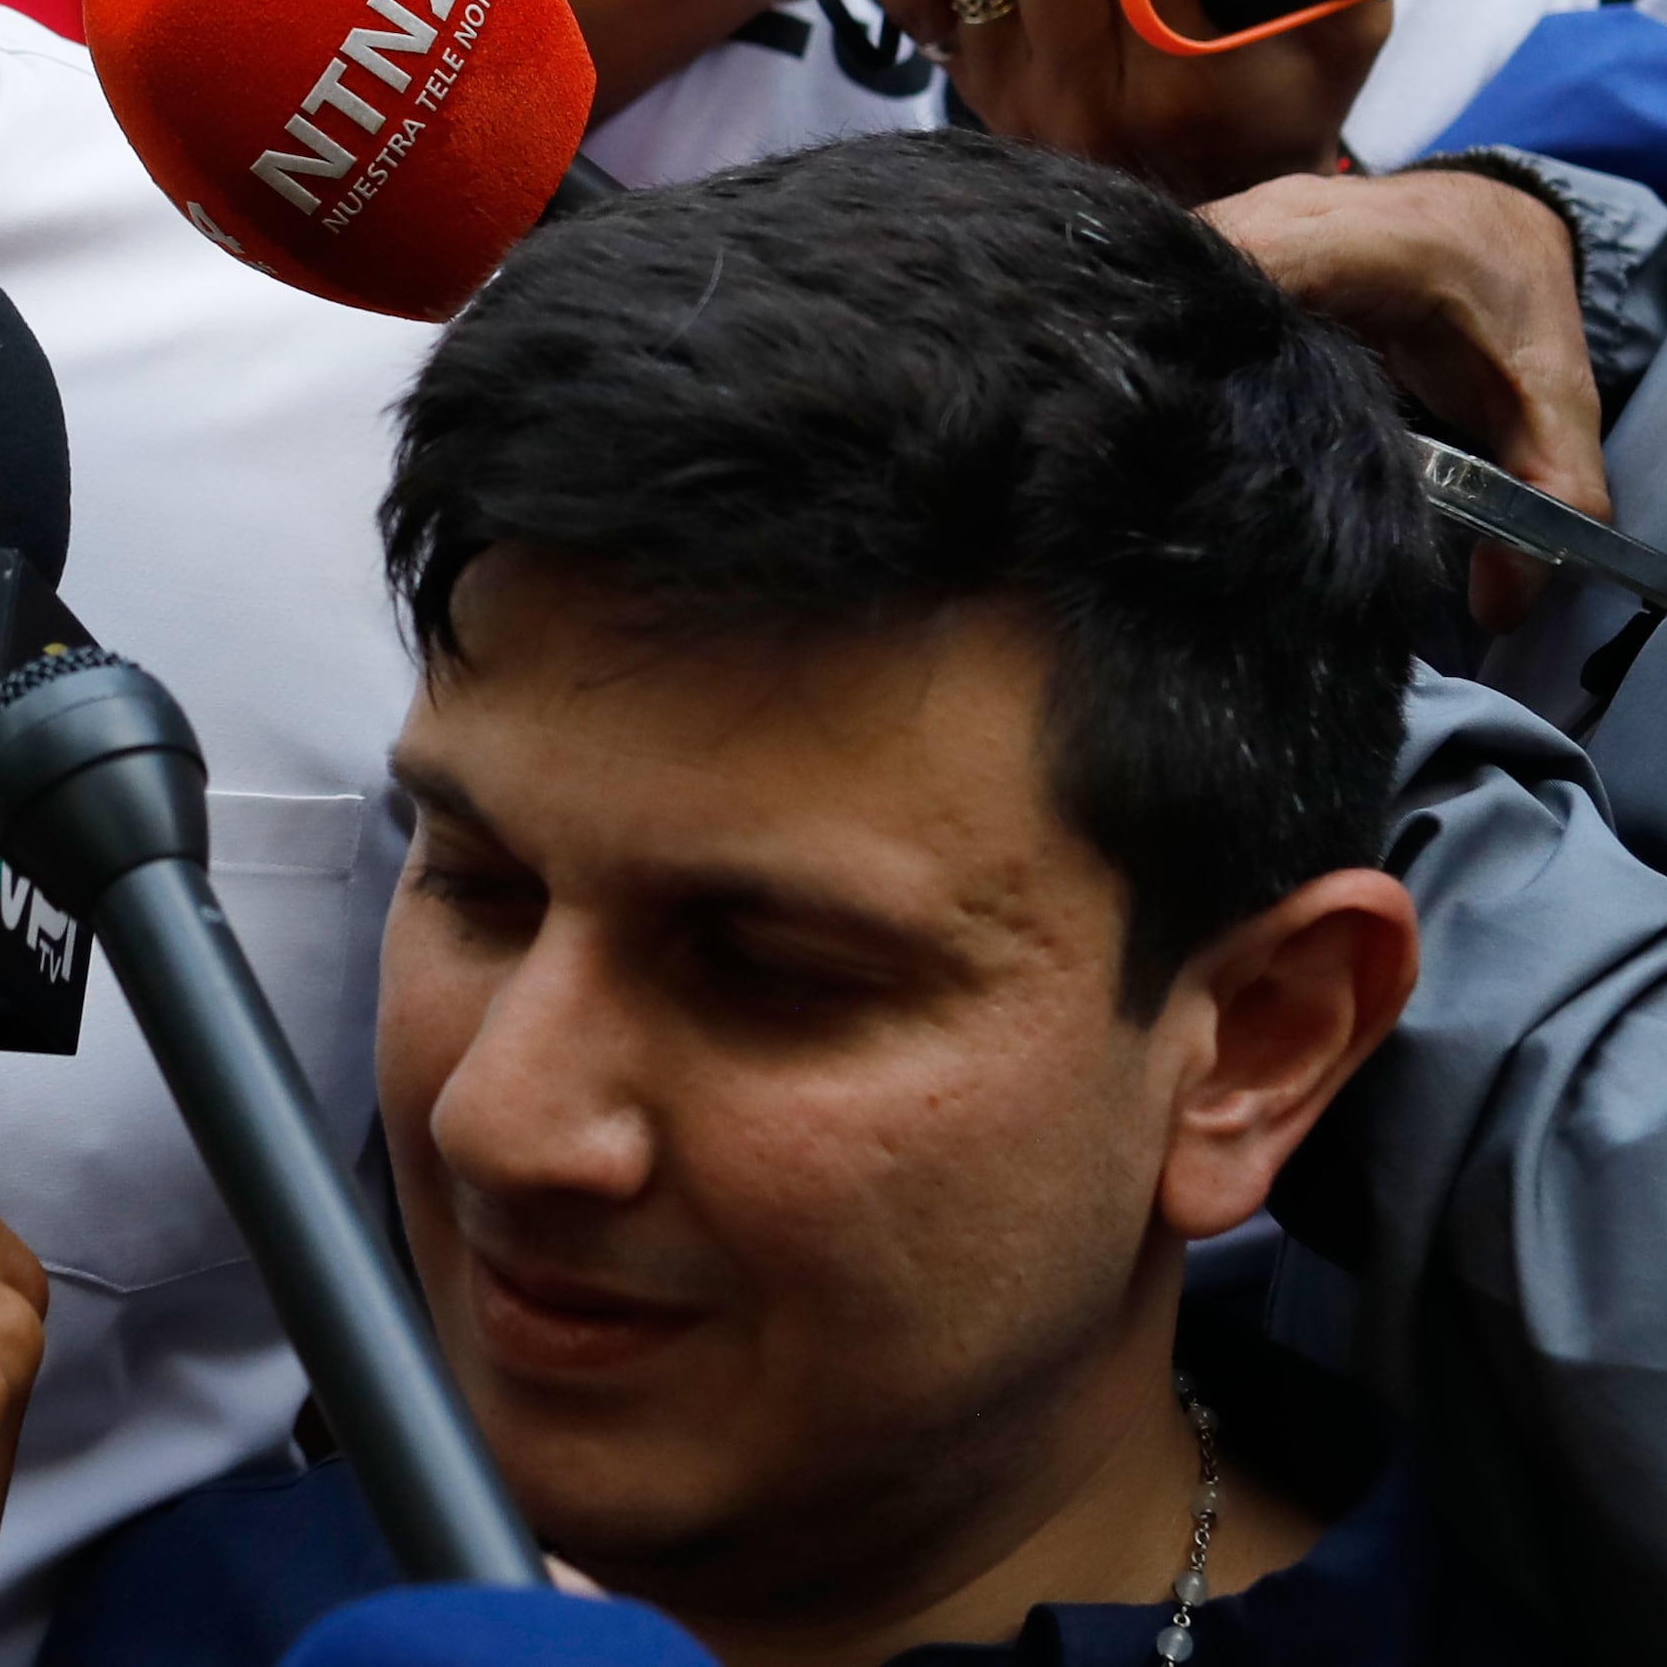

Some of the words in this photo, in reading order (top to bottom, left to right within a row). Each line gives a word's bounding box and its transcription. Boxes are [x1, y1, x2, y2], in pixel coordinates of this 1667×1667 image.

[321, 117, 427, 233] NUESTRA
[415, 46, 466, 115] TELE
[39, 938, 62, 984] TV
